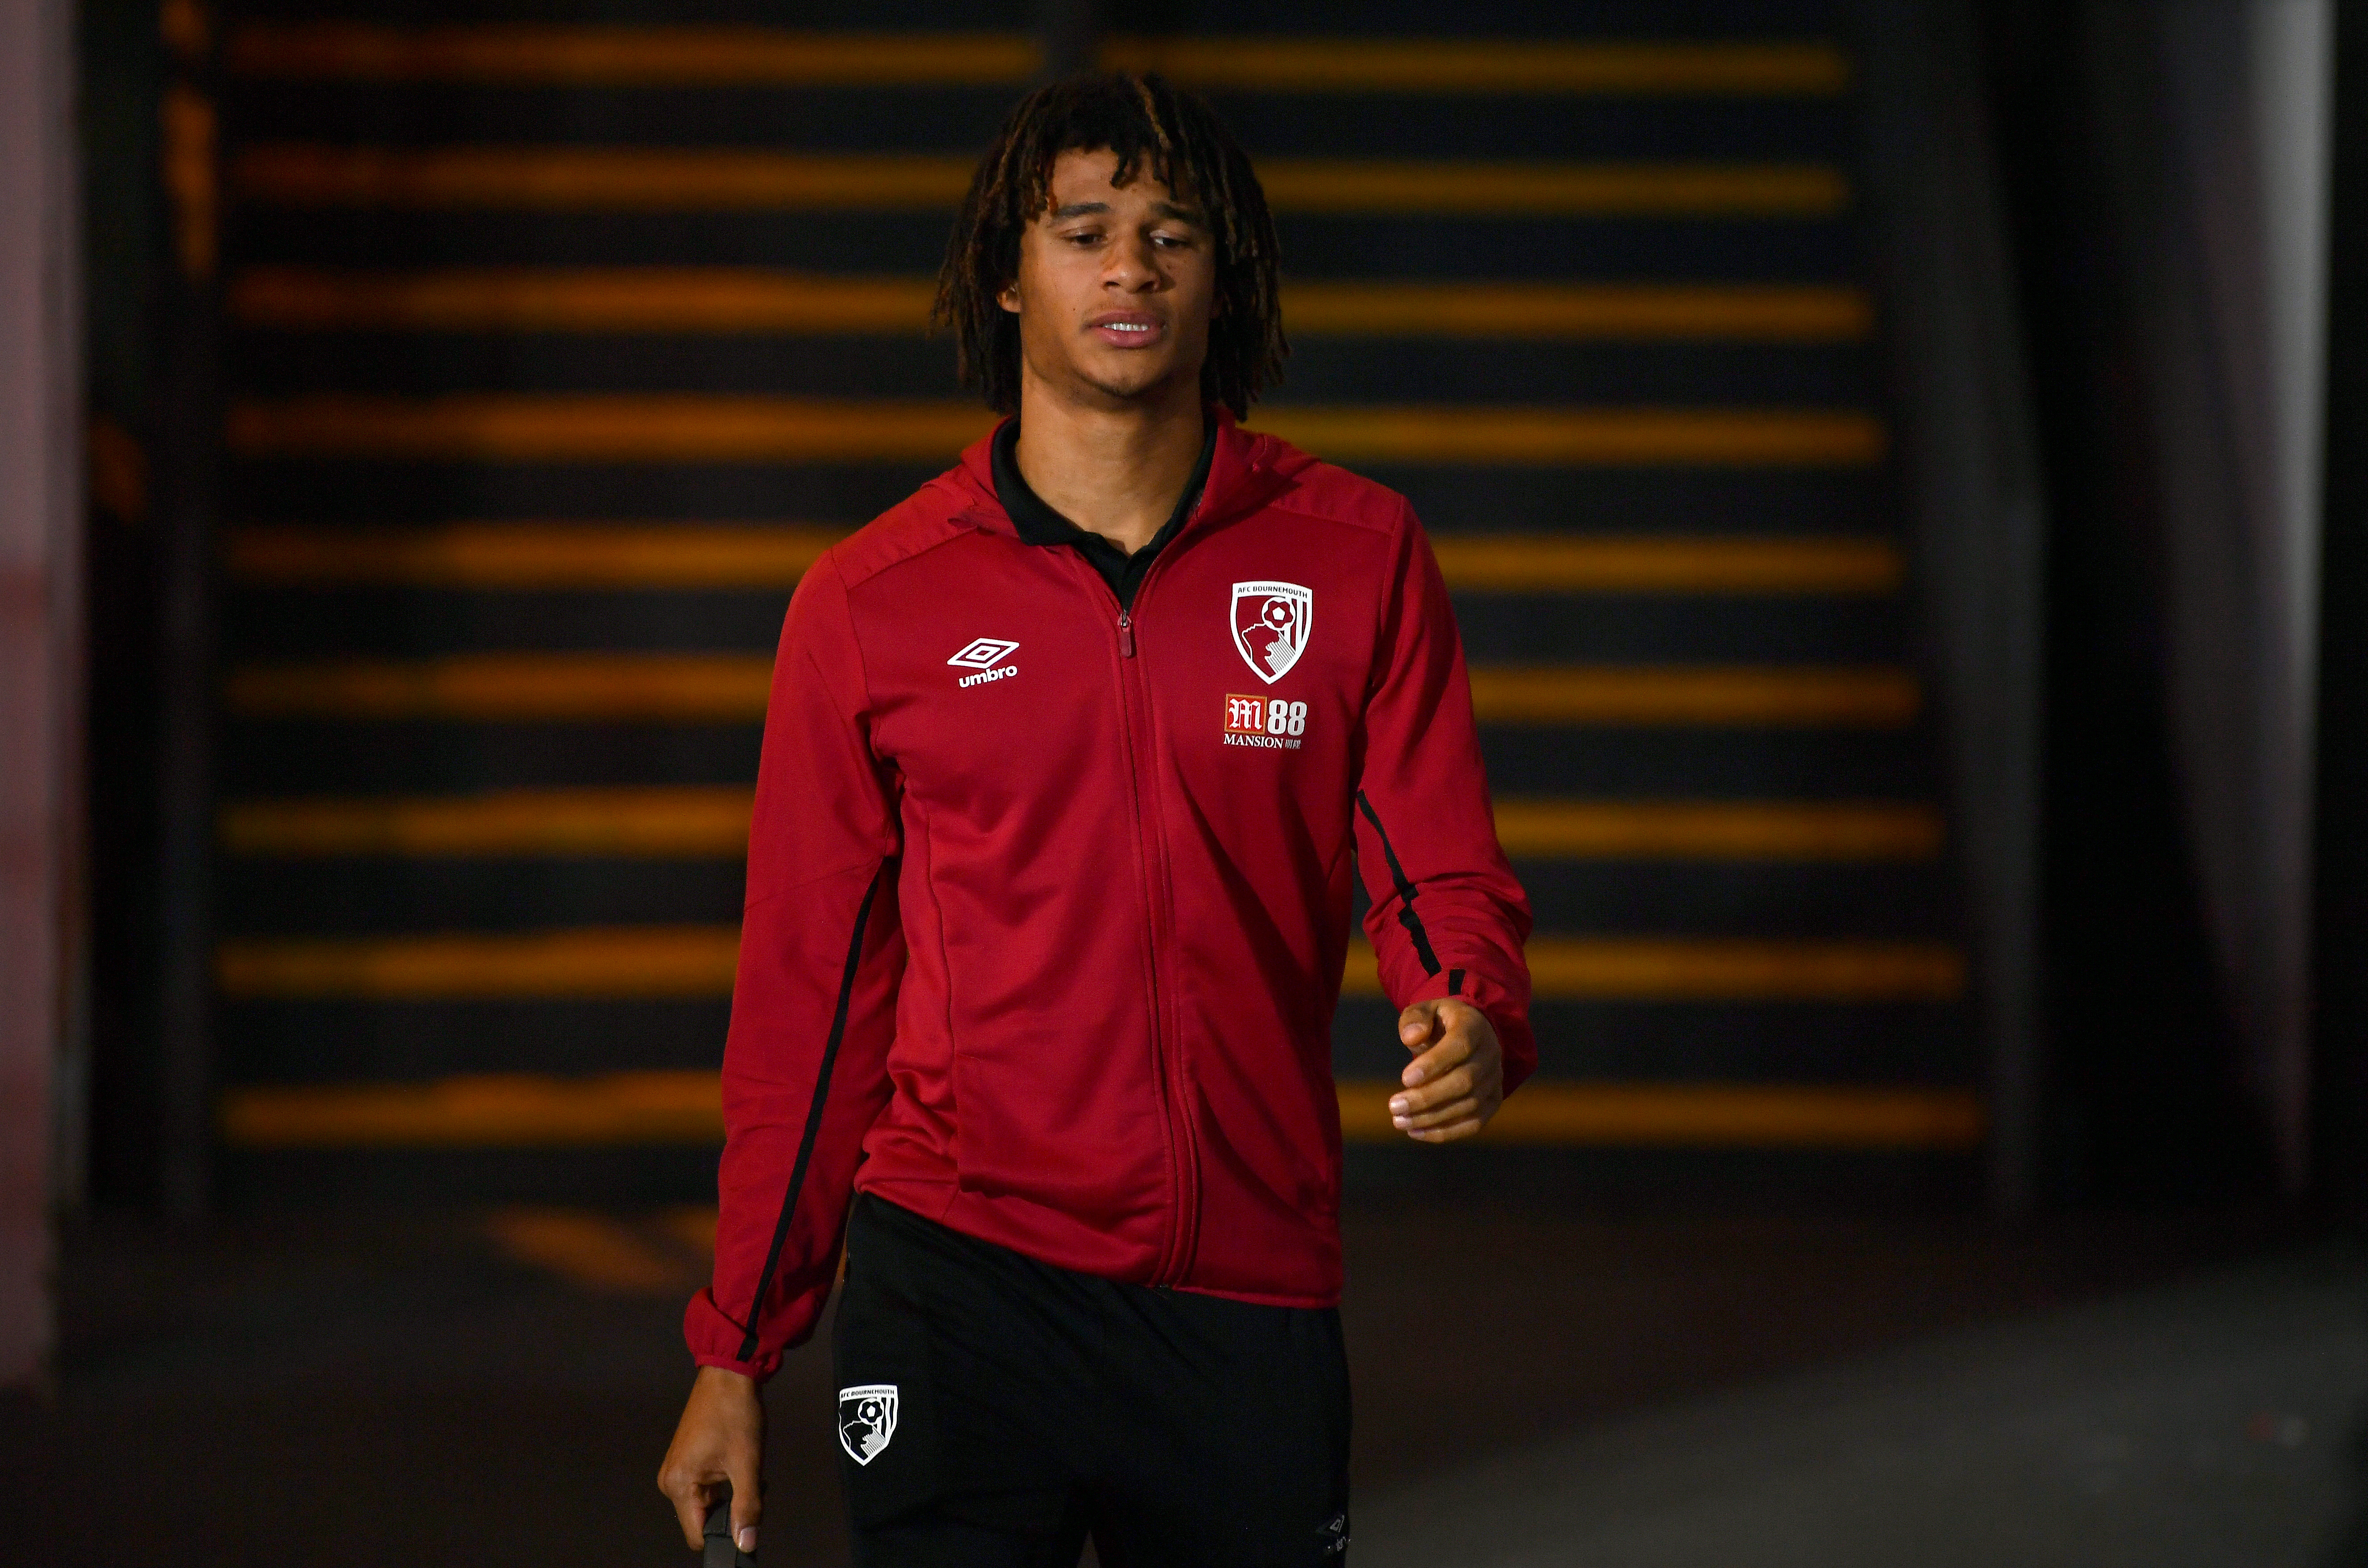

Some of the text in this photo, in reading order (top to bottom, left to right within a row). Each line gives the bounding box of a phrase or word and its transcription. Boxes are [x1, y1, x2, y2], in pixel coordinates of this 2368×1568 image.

[1253, 585, 1307, 599] BOURNEMOUTH
[959, 665, 1018, 688] umbro
[1223, 733, 1283, 749] MANSION
[851, 1388, 894, 1397] BOURNEMOUTH
